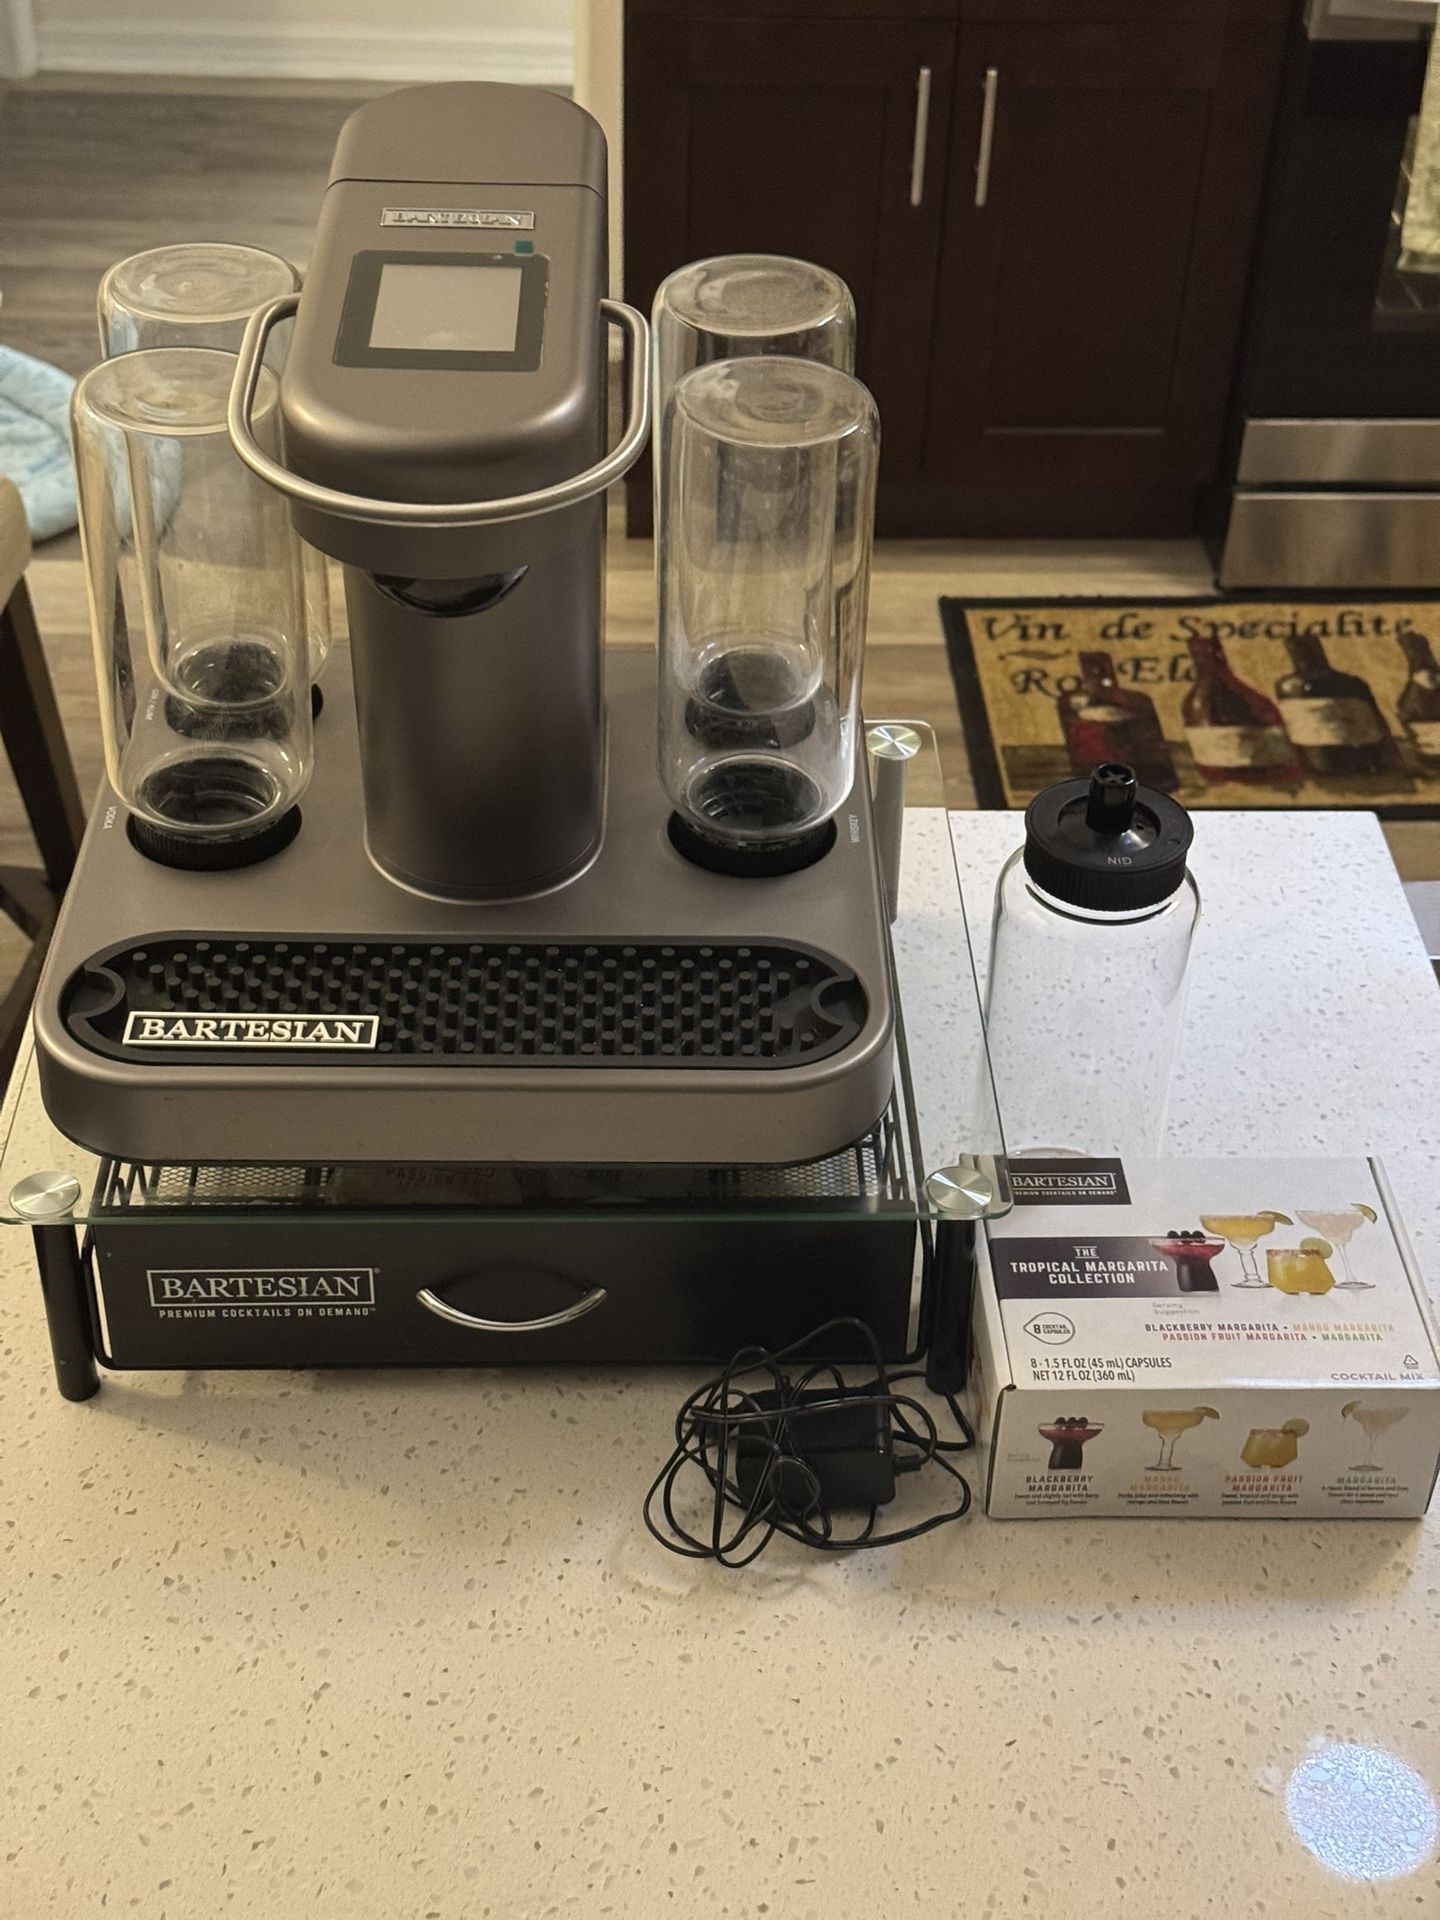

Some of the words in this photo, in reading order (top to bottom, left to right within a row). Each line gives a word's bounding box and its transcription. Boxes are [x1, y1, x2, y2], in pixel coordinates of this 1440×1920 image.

[983, 613, 1070, 641] Vin
[1100, 612, 1154, 640] de
[138, 1018, 365, 1043] BARTESIAN
[1012, 1176, 1108, 1187] BARTESIAN
[1075, 1249, 1097, 1257] THE
[1010, 1262, 1080, 1273] TROPICAL
[1085, 1261, 1168, 1272] MARGARITA
[1049, 1273, 1135, 1284] COLLECTION
[160, 1276, 361, 1298] BARTESIAN
[159, 1309, 216, 1319] PREMIUM
[222, 1308, 291, 1318] COCKTAILS
[298, 1308, 312, 1317] ON
[1033, 1324, 1041, 1334] 8
[1145, 1323, 1212, 1332] BLACKBERRY
[1218, 1323, 1279, 1331] MARGARITA
[1163, 1333, 1207, 1341] PASSION
[1211, 1333, 1241, 1341] FRUIT
[1246, 1333, 1307, 1341] MARGARITA
[1321, 1333, 1383, 1341] MARGARITA
[1030, 1358, 1037, 1368] 8
[1044, 1358, 1060, 1368] 1.5
[1062, 1358, 1073, 1368] FL
[1073, 1358, 1086, 1368] OZ
[1088, 1358, 1104, 1370] (45
[1106, 1358, 1124, 1370] mL)
[1125, 1357, 1172, 1368] CAPSULES
[1033, 1370, 1050, 1380] NET
[1052, 1370, 1064, 1380] 12
[1066, 1370, 1077, 1380] FL
[1078, 1370, 1092, 1380] OZ
[1093, 1370, 1115, 1382] (360
[1117, 1370, 1135, 1382] mL)
[1025, 1475, 1093, 1483] BLACKBERRY
